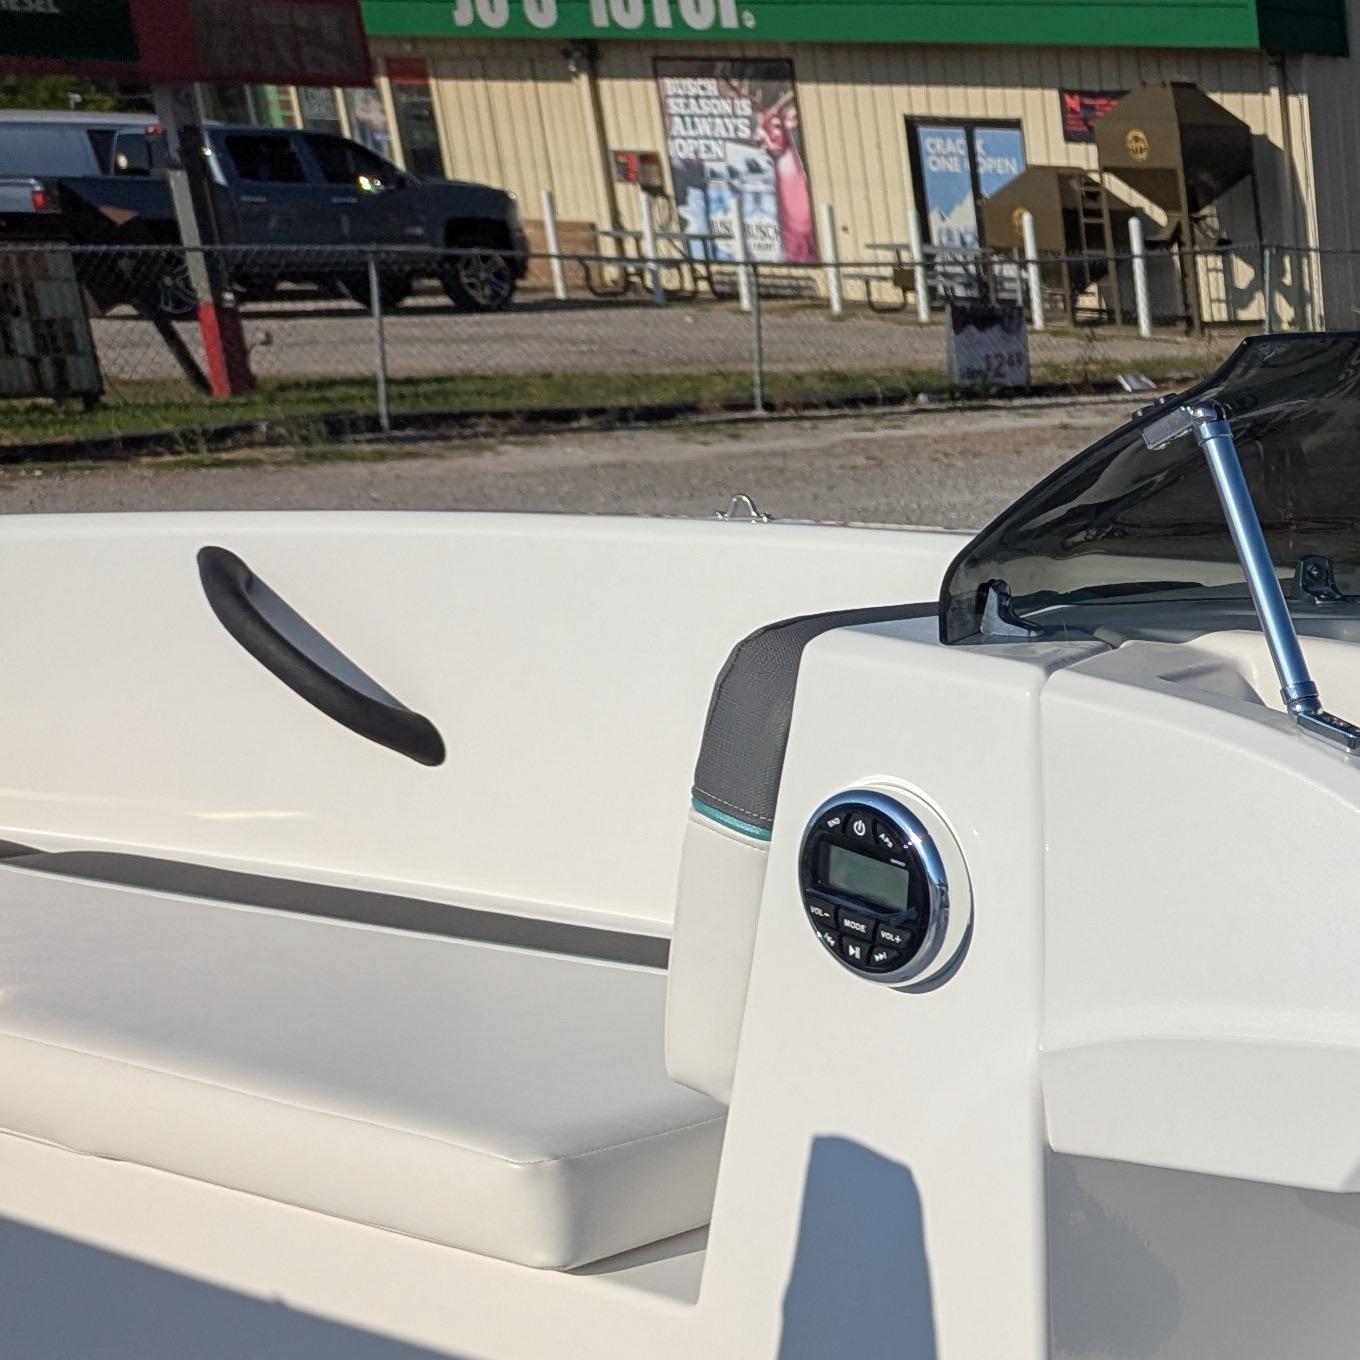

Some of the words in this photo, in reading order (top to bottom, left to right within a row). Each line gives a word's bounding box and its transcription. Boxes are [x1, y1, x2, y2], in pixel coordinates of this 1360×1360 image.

[668, 97, 732, 114] SEASON
[734, 97, 751, 114] IS
[671, 116, 751, 138] ALWAYS
[674, 139, 724, 160] OPEN
[929, 156, 961, 173] ONE
[844, 918, 866, 933] MODE
